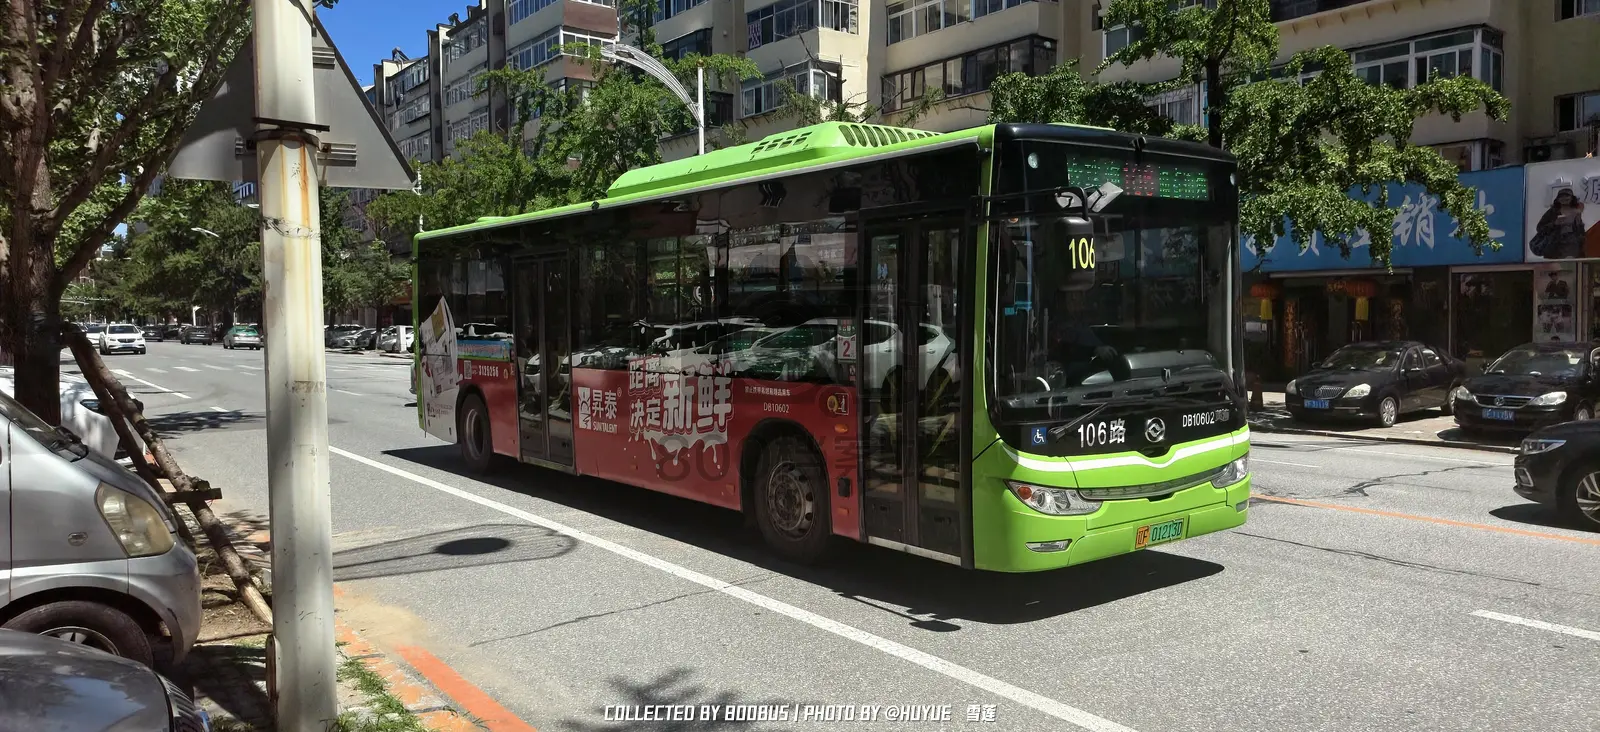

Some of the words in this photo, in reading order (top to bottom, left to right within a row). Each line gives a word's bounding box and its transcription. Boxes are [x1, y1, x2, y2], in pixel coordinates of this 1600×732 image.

[1068, 237, 1096, 270] 106
[842, 341, 850, 357] 2
[629, 357, 660, 390] 距离
[592, 389, 617, 419] 昇泰
[662, 362, 732, 430] 新鲜
[763, 401, 790, 413] DB10602
[629, 399, 660, 428] 决定
[1182, 411, 1215, 427] DB10602
[1077, 418, 1126, 448] 106路
